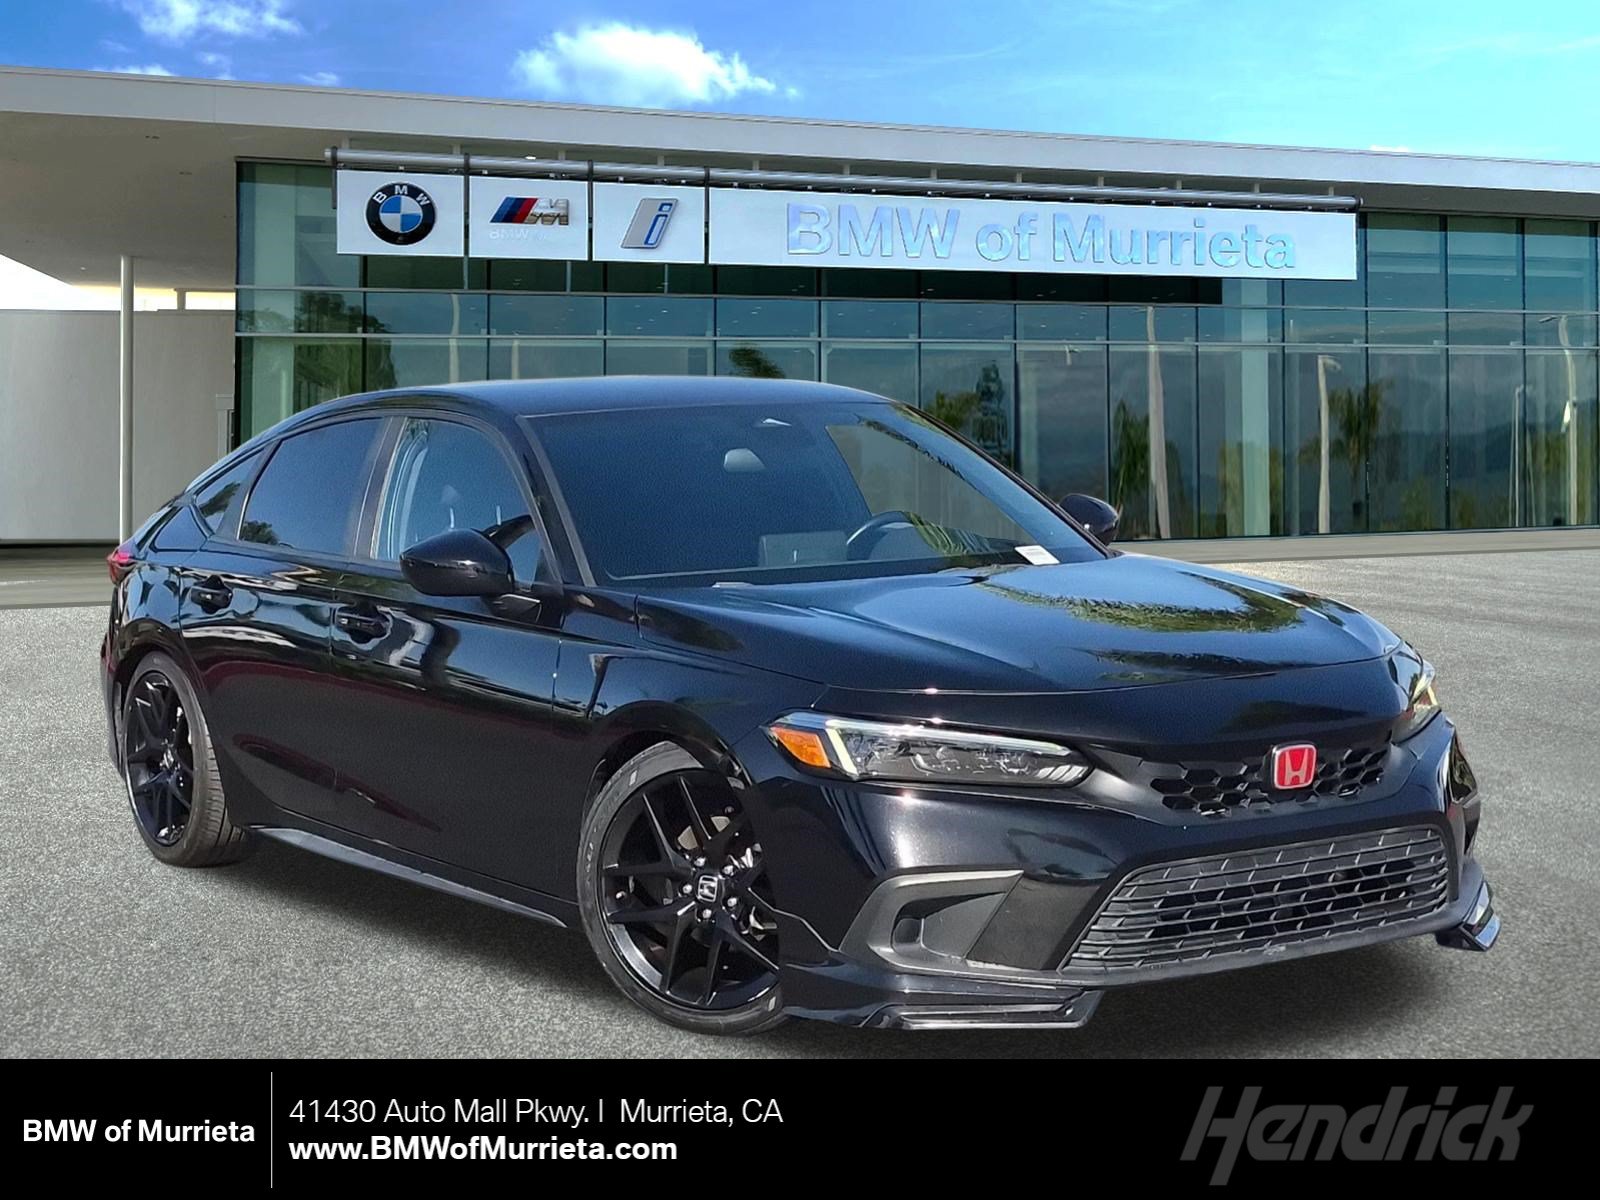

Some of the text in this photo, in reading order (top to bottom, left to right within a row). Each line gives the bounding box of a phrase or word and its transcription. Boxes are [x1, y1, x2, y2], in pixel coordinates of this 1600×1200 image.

[373, 185, 430, 205] BMW
[787, 203, 1296, 269] BMW of Murrieta
